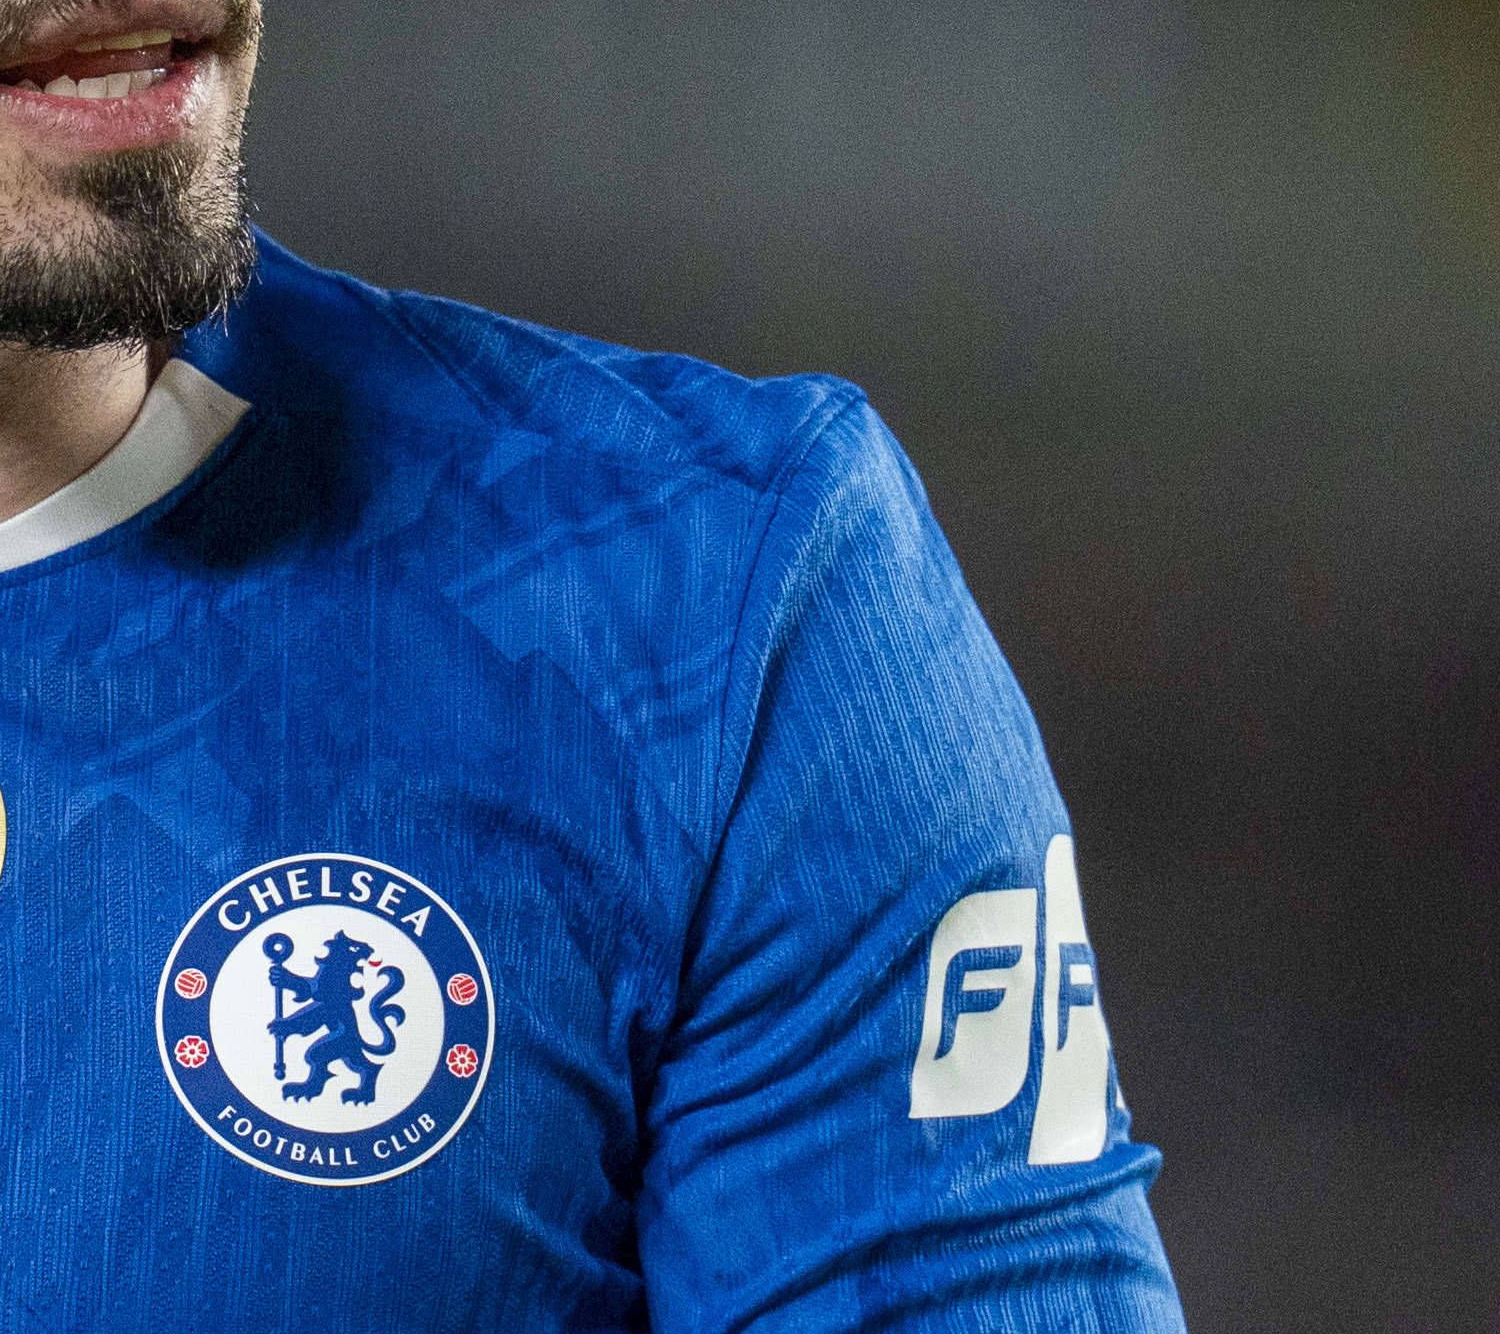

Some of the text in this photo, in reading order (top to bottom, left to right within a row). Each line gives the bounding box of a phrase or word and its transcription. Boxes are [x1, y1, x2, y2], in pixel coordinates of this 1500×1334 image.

[217, 867, 432, 937] CHELSEA
[217, 1104, 437, 1166] FOOTBALL CLUB
